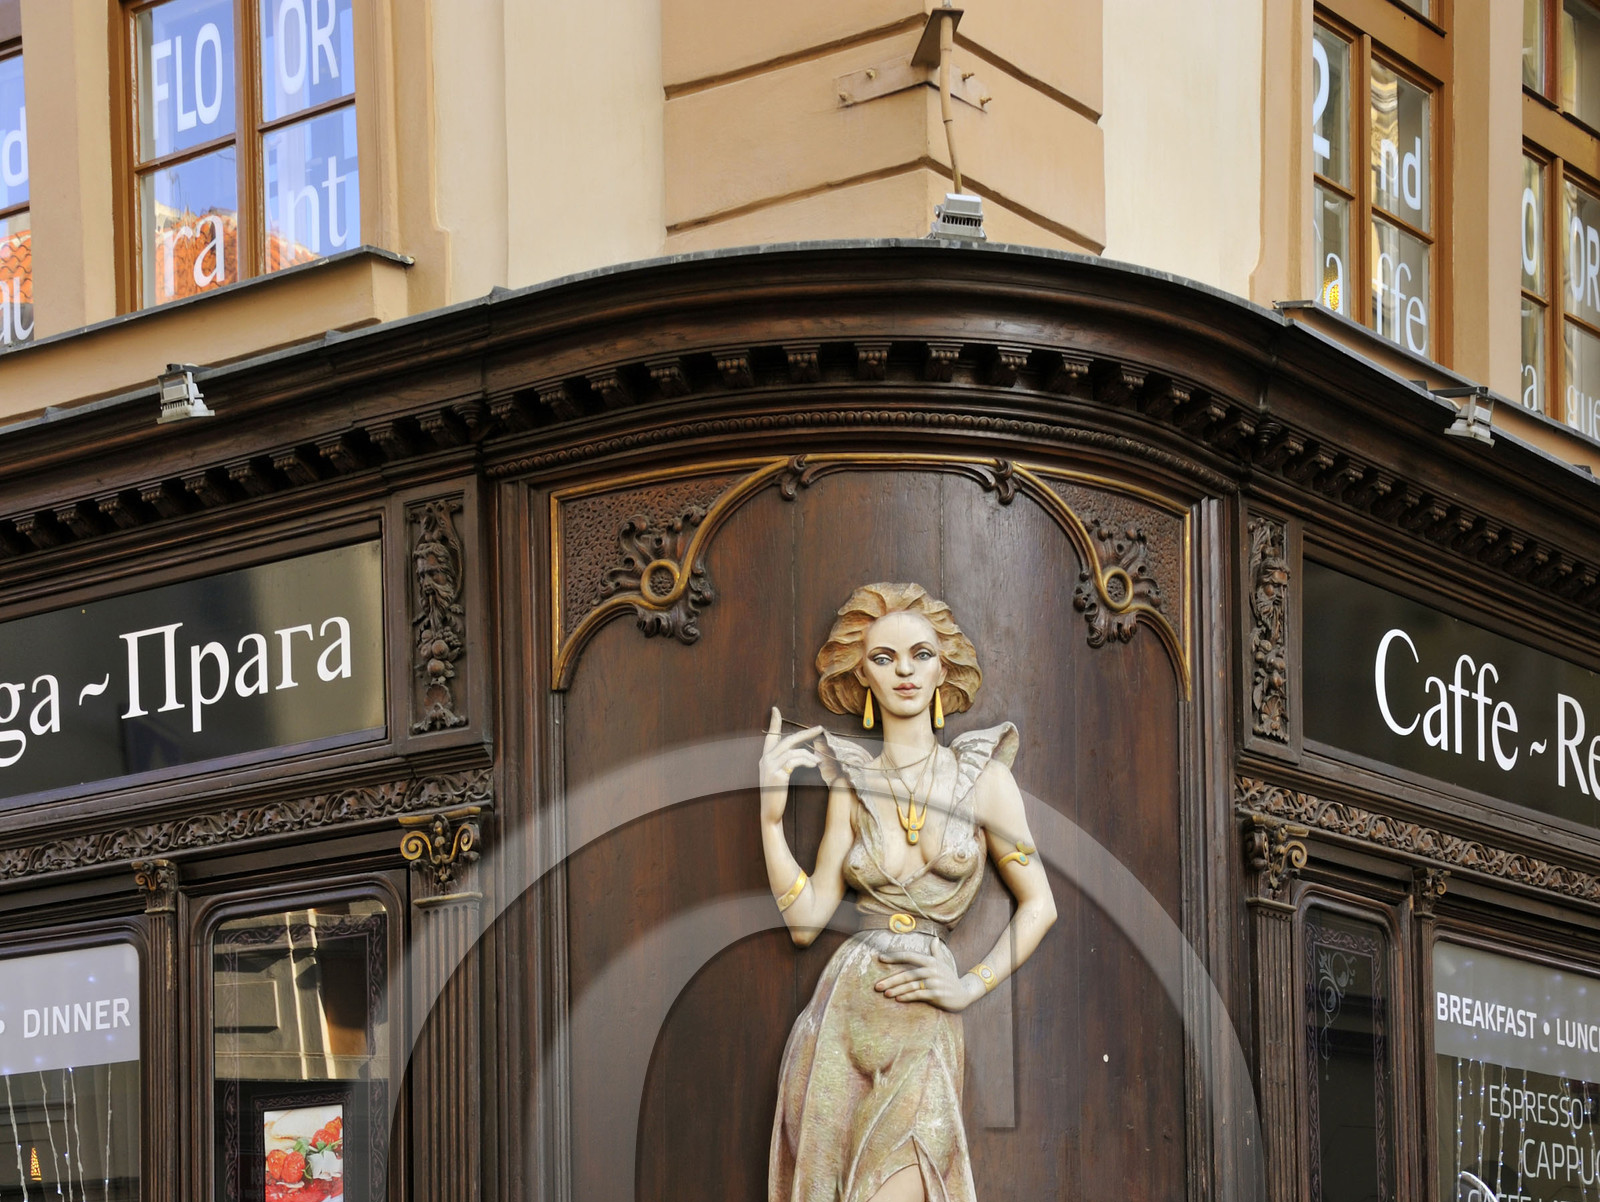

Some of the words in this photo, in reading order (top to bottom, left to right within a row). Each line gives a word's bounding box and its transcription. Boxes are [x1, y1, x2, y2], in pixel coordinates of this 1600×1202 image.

[119, 616, 351, 733] Прага
[1375, 629, 1518, 771] Caffe
[24, 998, 130, 1038] DINNER
[1437, 991, 1537, 1039] BREAKFAST
[1556, 1018, 1600, 1053] LUNC
[1490, 1085, 1583, 1130] ESPRESSO
